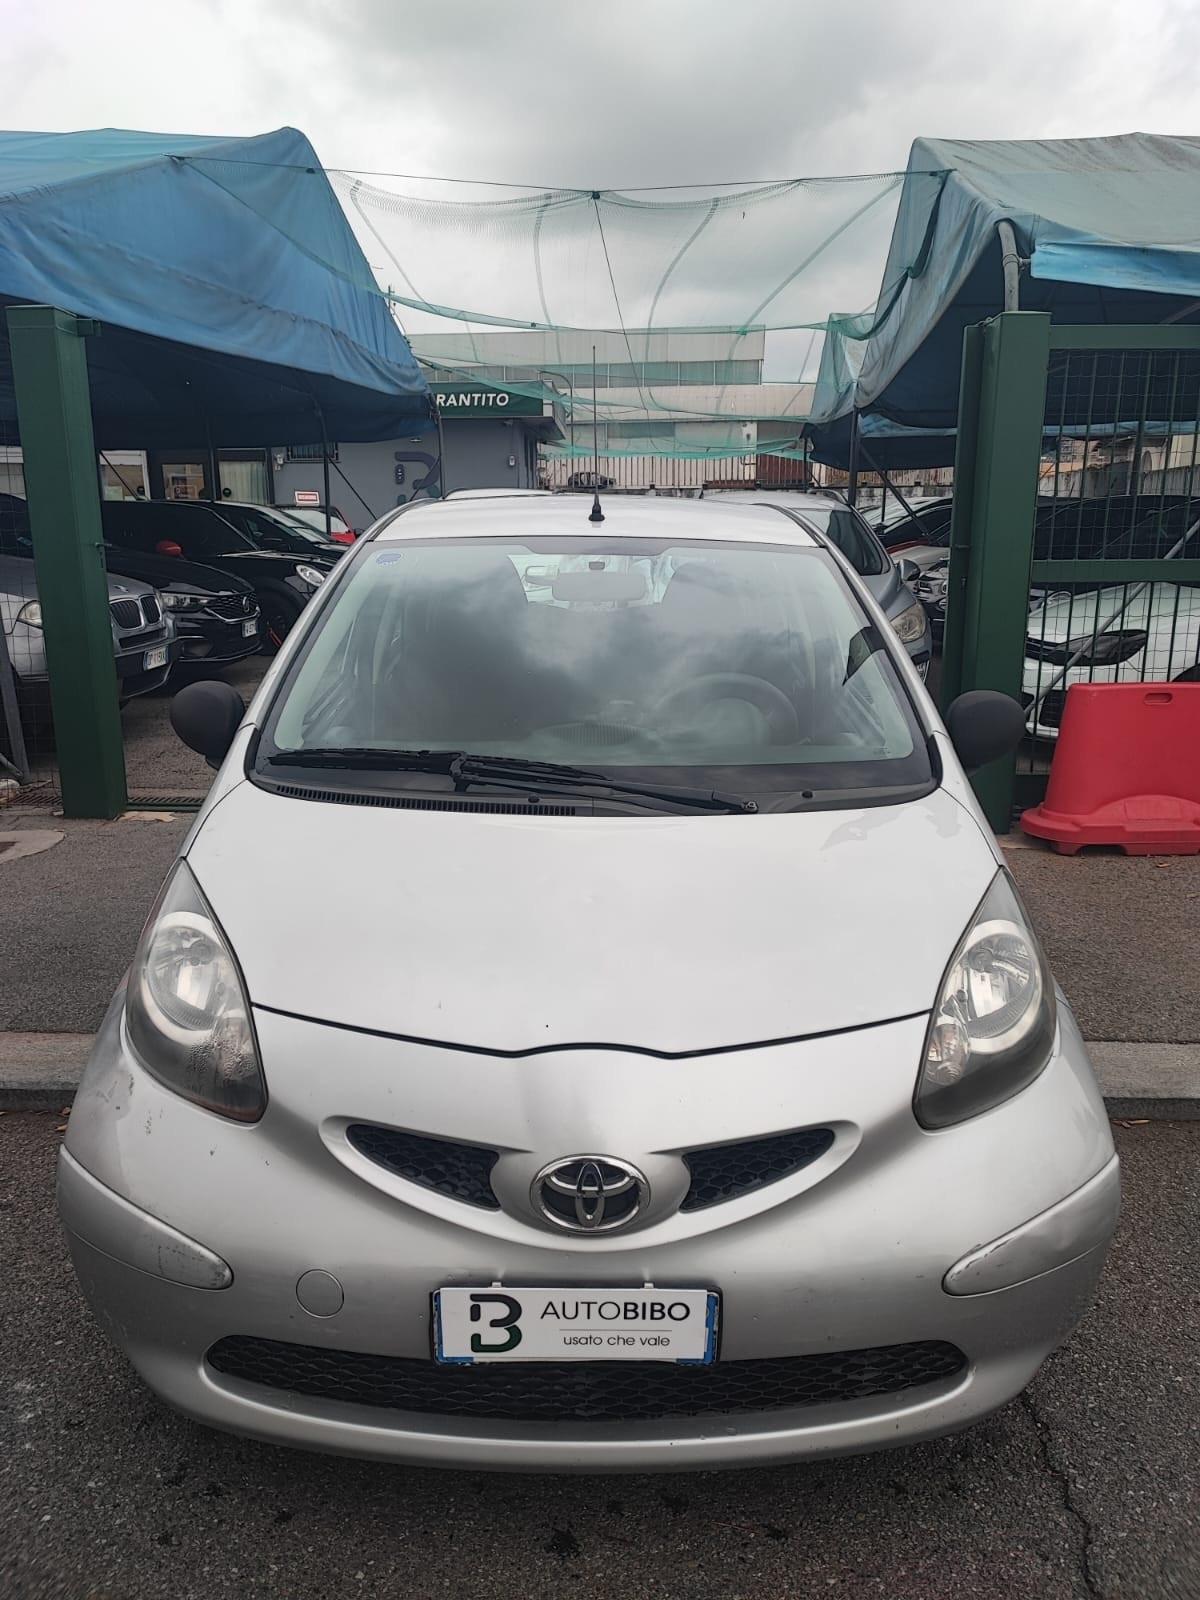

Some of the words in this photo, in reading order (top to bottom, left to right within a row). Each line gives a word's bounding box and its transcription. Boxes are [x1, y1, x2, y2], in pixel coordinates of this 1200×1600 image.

[436, 393, 509, 407] RANTITO
[540, 1301, 691, 1321] AUTOBIBO
[563, 1335, 603, 1347] usato
[607, 1335, 636, 1347] che
[639, 1335, 671, 1347] vale
